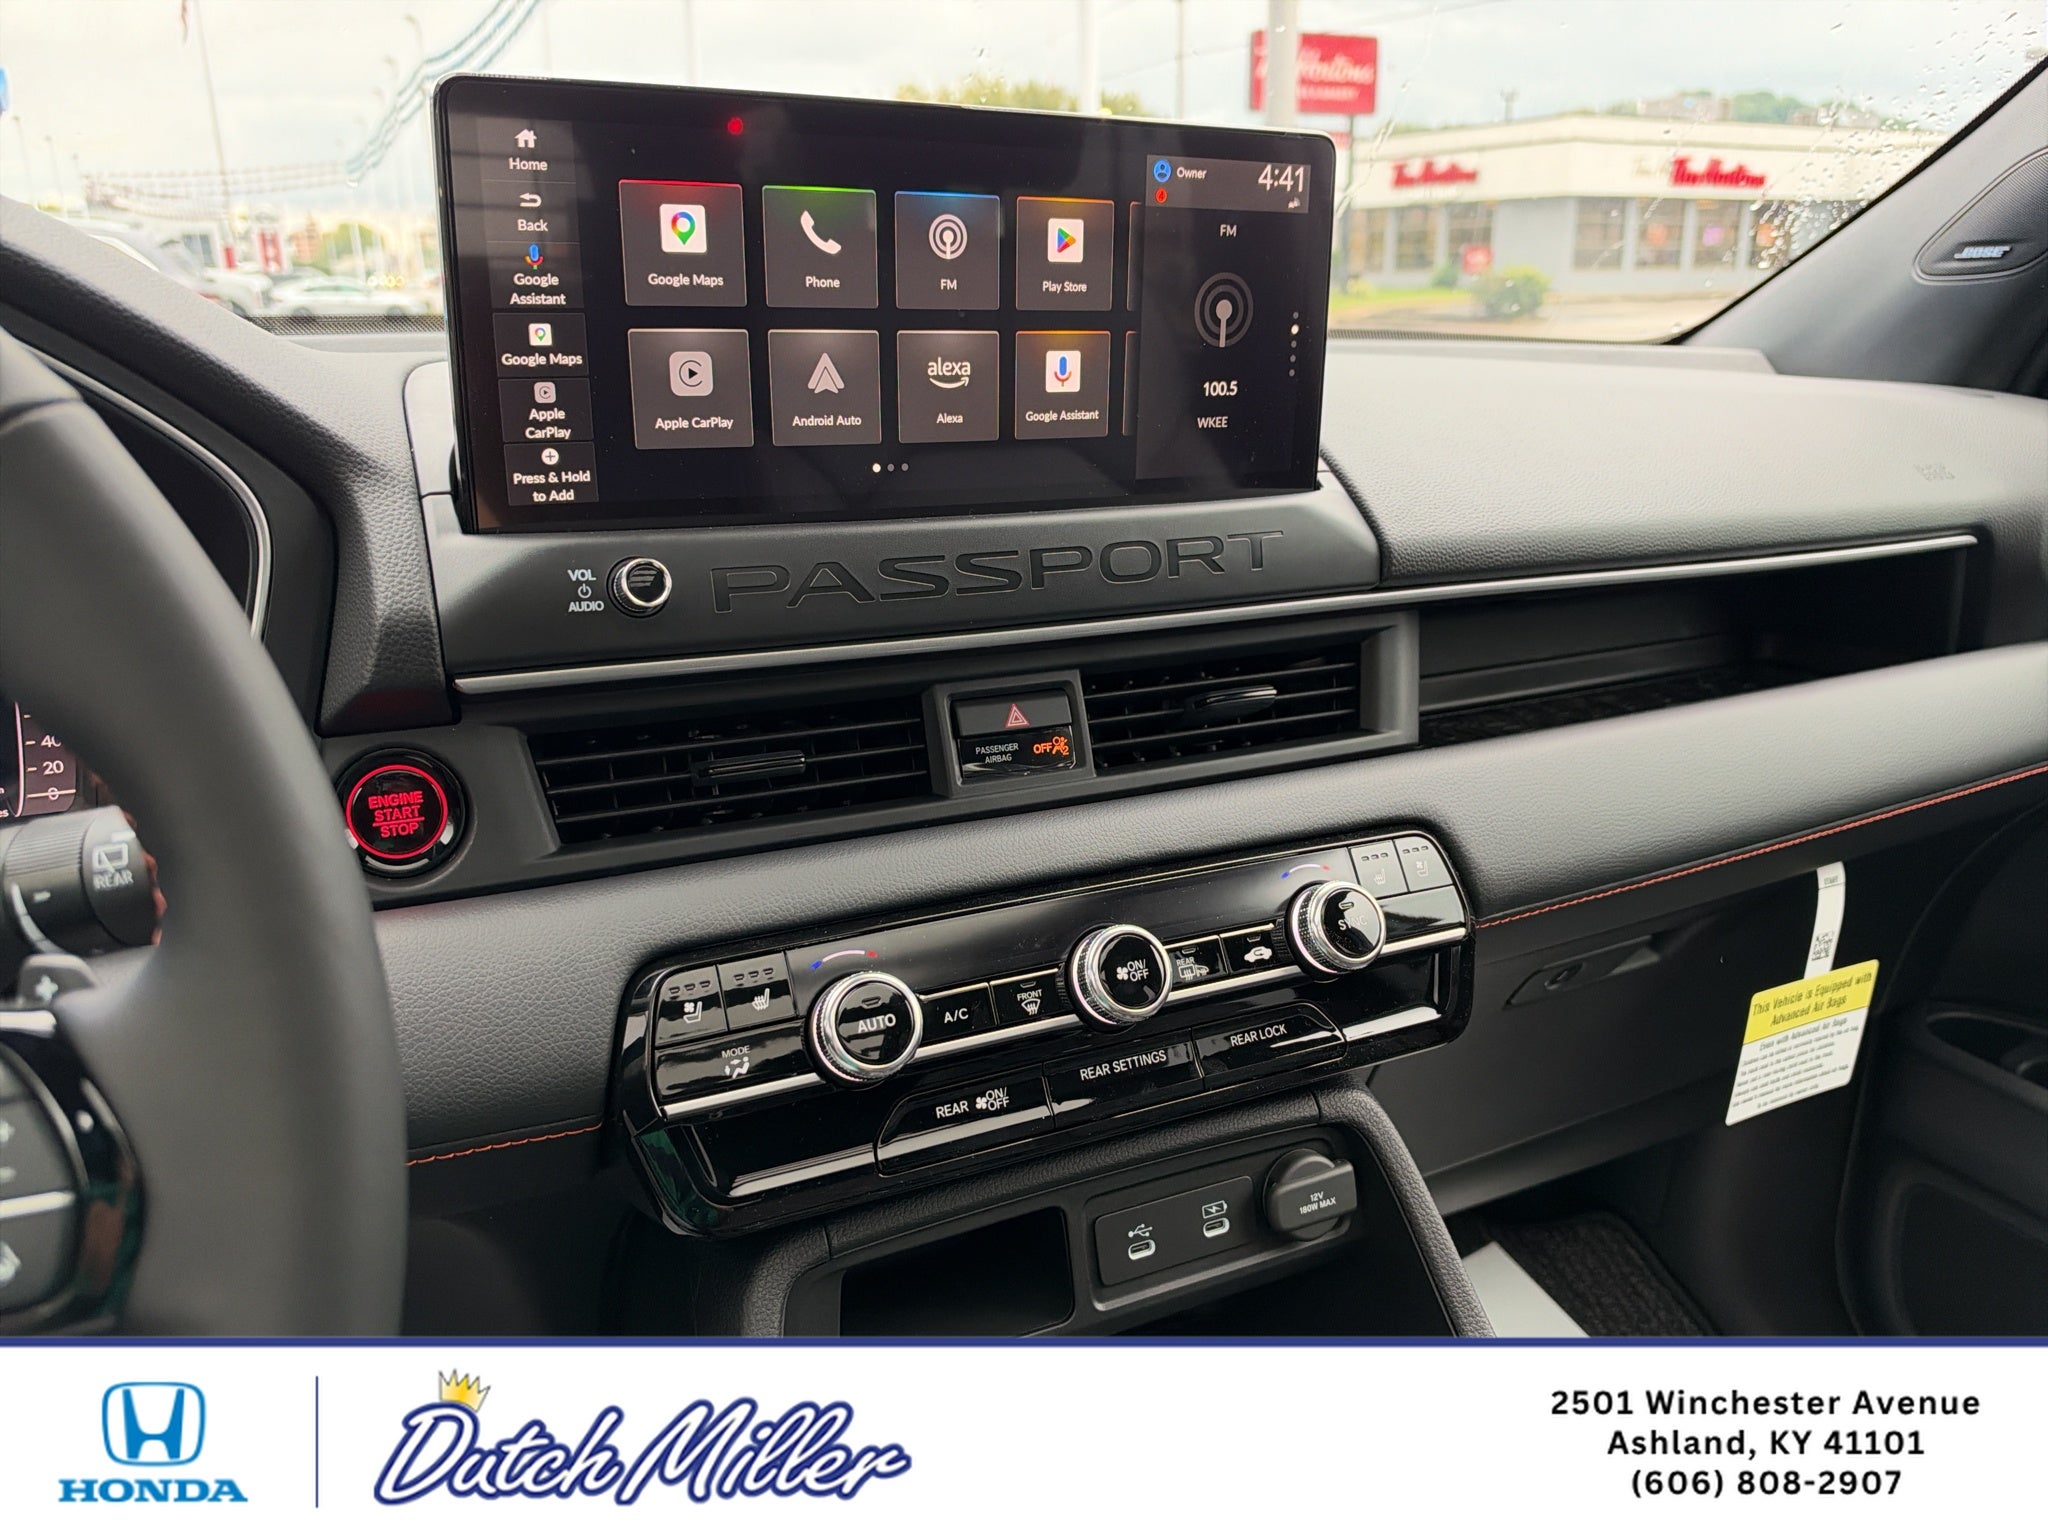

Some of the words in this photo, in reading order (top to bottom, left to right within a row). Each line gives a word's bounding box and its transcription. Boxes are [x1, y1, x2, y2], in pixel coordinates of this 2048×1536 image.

[508, 157, 548, 171] Home
[1176, 167, 1207, 180] Owner
[1258, 163, 1304, 192] 4:41
[517, 219, 548, 232] Back
[1219, 224, 1237, 237] FM
[513, 273, 559, 288] Google
[648, 273, 691, 288] Google
[692, 273, 724, 288] Maps
[805, 276, 841, 288] Phone
[940, 279, 957, 291] FM
[1042, 281, 1061, 294] Play
[1063, 281, 1088, 293] Store
[509, 292, 566, 305] Assistant
[501, 353, 547, 368] Google
[550, 353, 583, 367] Maps
[927, 357, 971, 377] alexa
[1203, 380, 1238, 397] 100.5
[529, 408, 566, 422] Apple
[792, 415, 834, 427] Android
[836, 414, 862, 426] Auto
[936, 412, 964, 424] Alexa
[1025, 410, 1058, 423] Google
[1060, 409, 1099, 421] Assistant
[1197, 416, 1229, 428] WKEE
[655, 417, 689, 431] Apple
[691, 417, 734, 430] CarPlay
[525, 426, 572, 440] CarPlay
[513, 472, 546, 485] Press
[548, 471, 559, 484] &
[561, 470, 591, 483] Hold
[533, 491, 546, 502] to
[549, 489, 574, 502] Add
[567, 568, 597, 581] VOL
[710, 530, 1285, 614] PASSPORT
[568, 600, 604, 612] AUDIO
[975, 742, 1019, 755] PASSENGER
[1033, 742, 1052, 754] OFF
[985, 754, 1012, 764] AIRBAG
[42, 760, 64, 775] 20
[48, 787, 59, 800] 0
[368, 790, 424, 809] ENGINE
[374, 805, 421, 822] START
[380, 822, 419, 838] STOP
[93, 868, 134, 891] REAR
[1127, 957, 1147, 973] ON/
[1176, 957, 1195, 968] REAR
[1129, 967, 1149, 983] OFF
[1016, 989, 1043, 1002] FRONT
[1752, 1000, 1770, 1016] This
[1773, 991, 1803, 1010] Vehicle
[1814, 976, 1853, 998] Equipped
[1855, 972, 1872, 985] with
[857, 1012, 897, 1034] AUTO
[944, 1007, 970, 1024] A/C
[1770, 1004, 1811, 1027] Advanced
[1230, 1030, 1259, 1047] REAR
[1259, 1023, 1288, 1041] LOCK
[721, 1044, 751, 1060] MODE
[1080, 1061, 1112, 1081] REAR
[1113, 1049, 1167, 1075] SETTINGS
[985, 1086, 1008, 1103] ON/
[935, 1100, 969, 1119] REAR
[988, 1096, 1010, 1112] OFF
[1310, 1191, 1324, 1202] 12V
[1299, 1201, 1318, 1215] 180W
[1319, 1197, 1336, 1209] MAX
